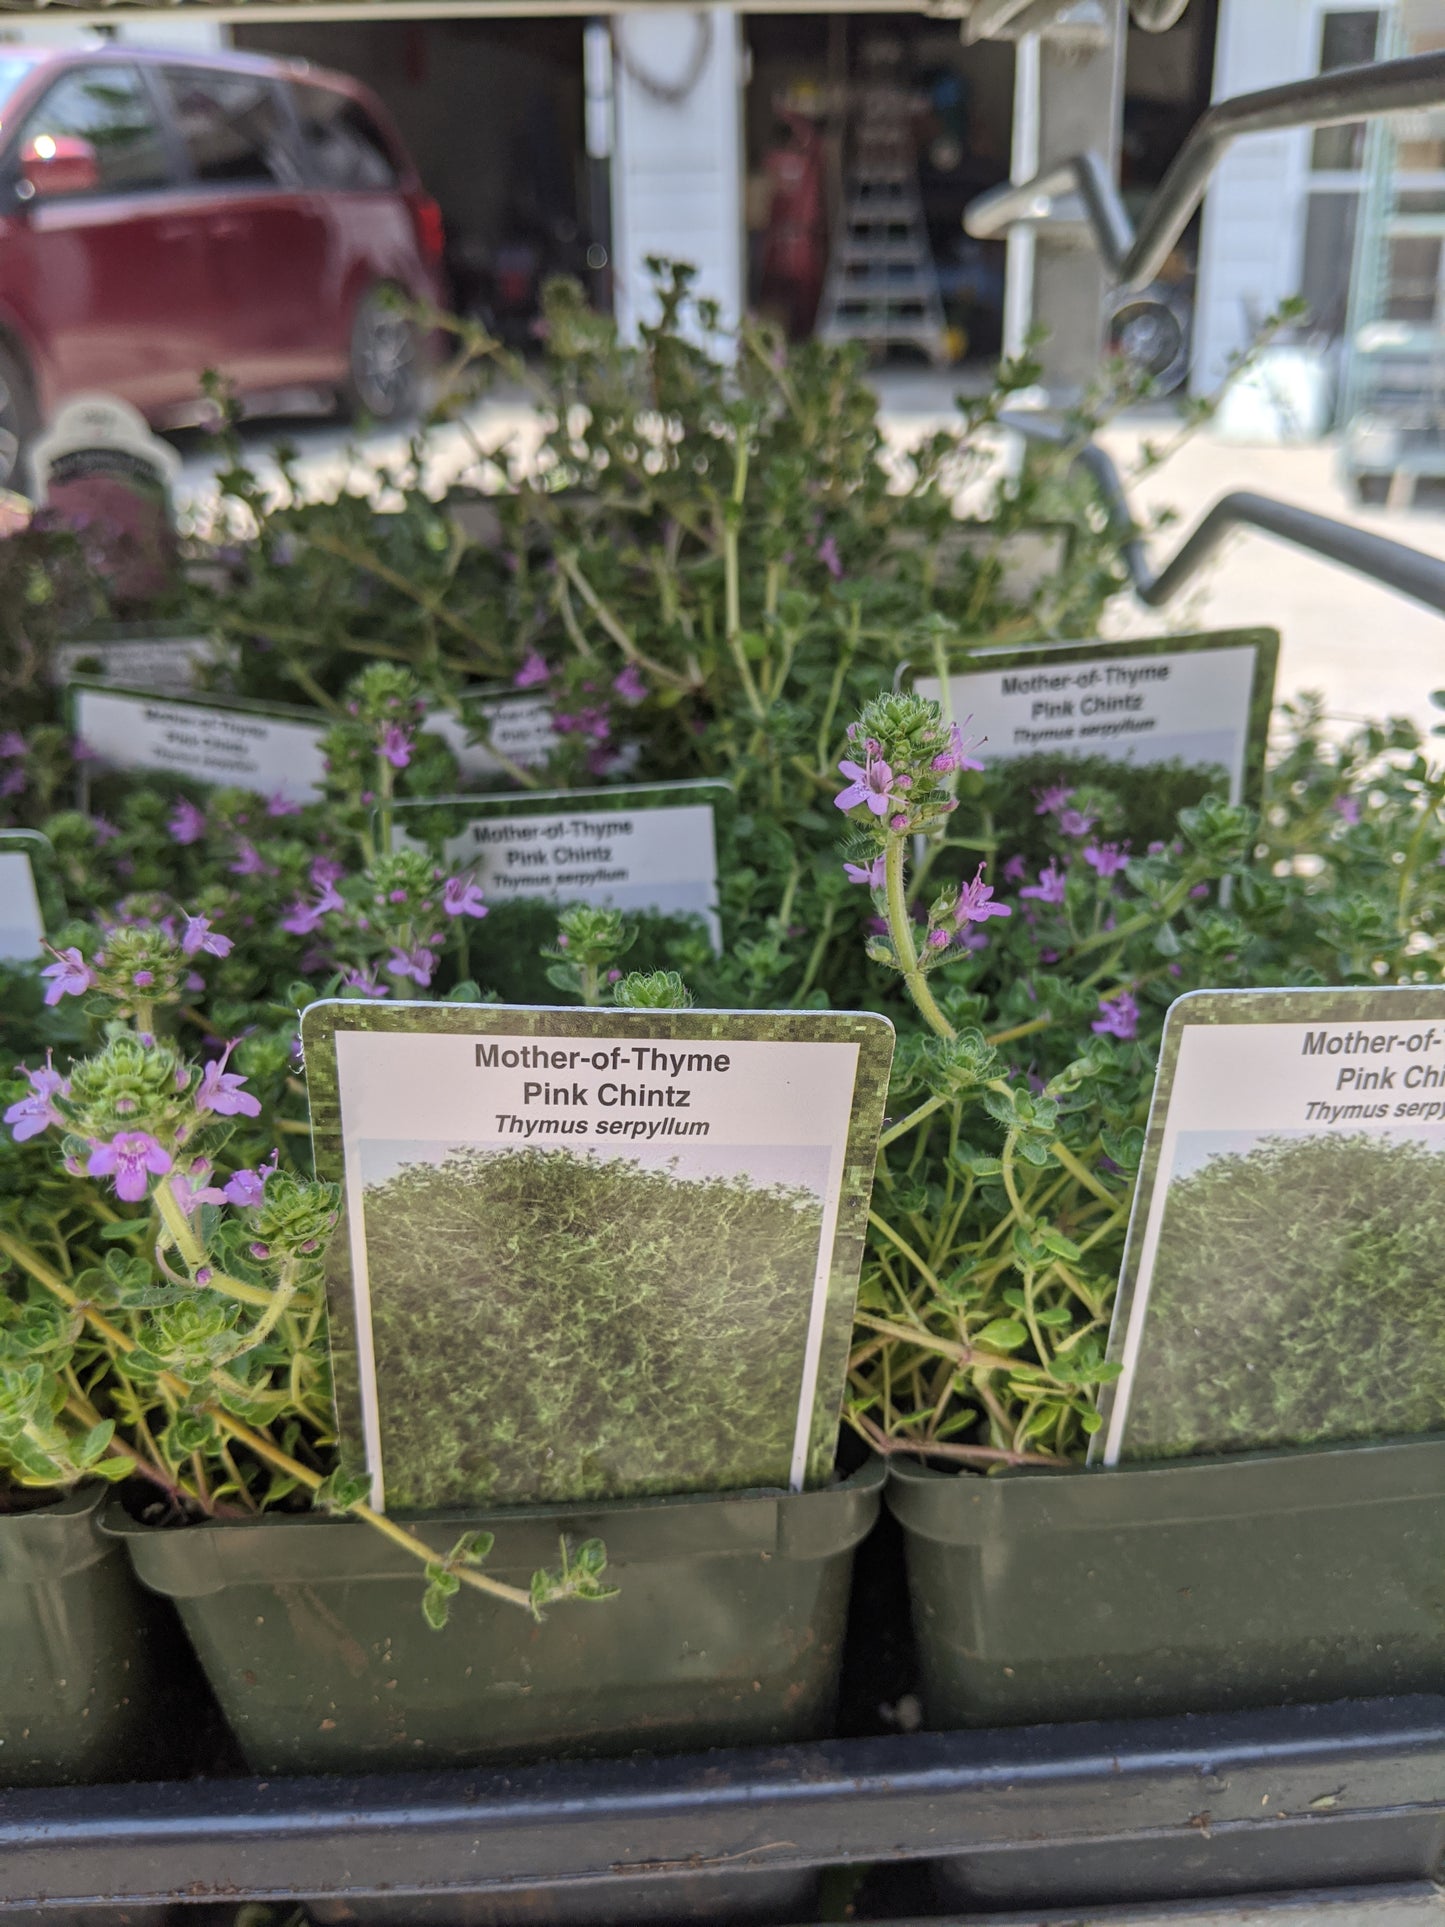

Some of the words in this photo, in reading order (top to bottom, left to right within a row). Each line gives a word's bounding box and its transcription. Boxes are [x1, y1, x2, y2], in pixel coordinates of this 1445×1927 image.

[1002, 665, 1170, 695] Mother-of-Thyme
[1031, 701, 1074, 720] Pink
[1080, 695, 1143, 716] Chintz
[474, 820, 634, 843] Mother-of-Thyme
[507, 849, 547, 867] Pink
[553, 846, 613, 865] Chintz
[493, 873, 552, 890] Thymus
[1301, 1027, 1445, 1056] Mother-of-
[475, 1043, 731, 1078] Mother-of-Thyme
[1336, 1066, 1398, 1091] Pink
[523, 1081, 589, 1106] Pink
[597, 1083, 691, 1108] Chintz
[1305, 1101, 1390, 1125] Thymus
[495, 1115, 589, 1138] Thymus
[595, 1117, 710, 1140] serpyllum
